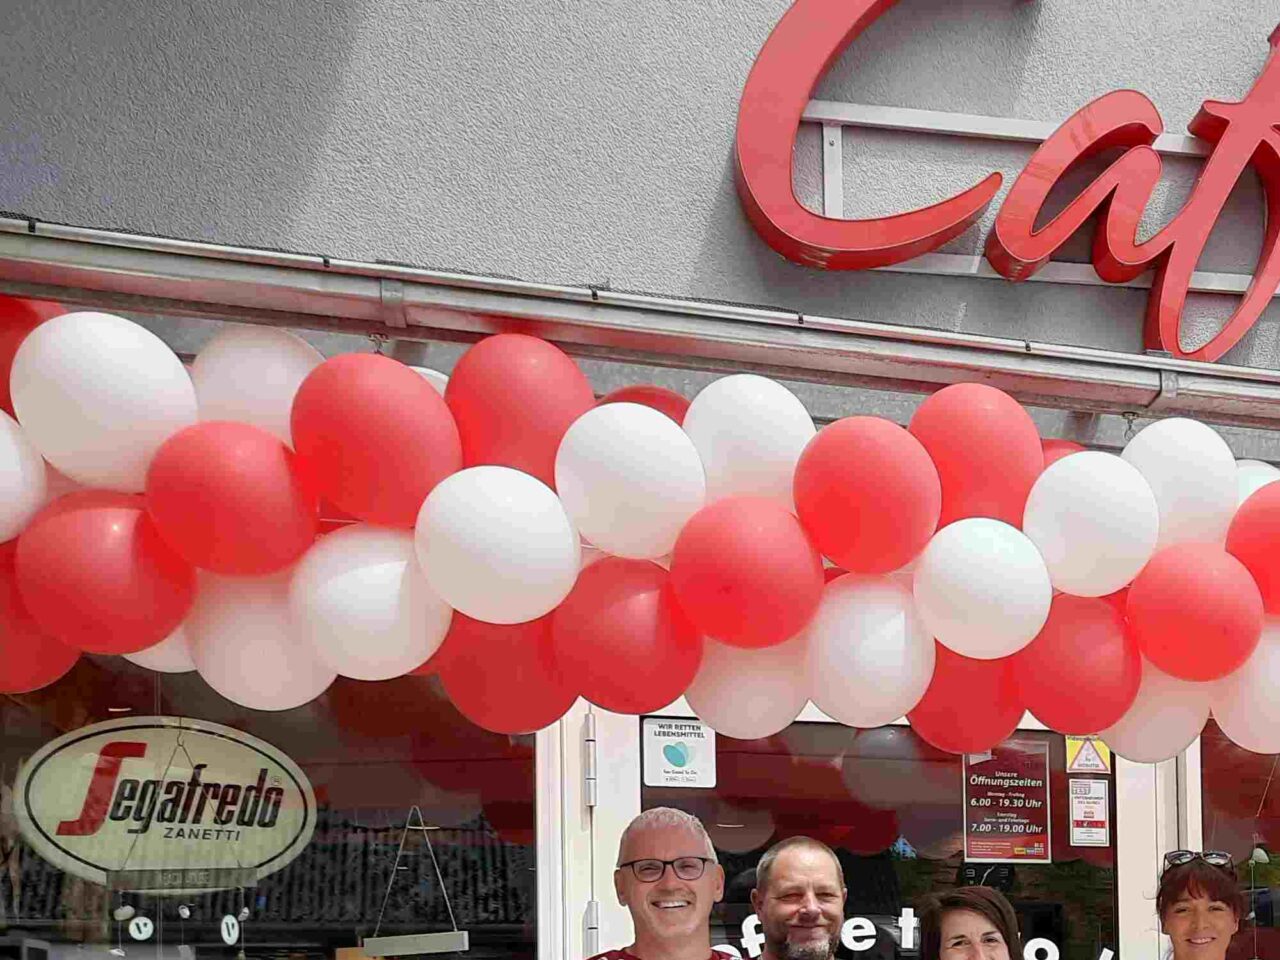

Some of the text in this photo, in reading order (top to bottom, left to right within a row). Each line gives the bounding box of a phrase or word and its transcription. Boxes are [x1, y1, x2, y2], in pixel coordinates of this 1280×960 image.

[674, 723, 702, 731] RETTEN
[653, 730, 706, 739] LEBENSMITTEL
[995, 770, 1018, 778] Unsere
[970, 774, 1043, 788] Öffnungszeiten
[56, 741, 285, 838] Segafredo
[970, 797, 992, 807] 6.00
[999, 798, 1024, 808] 19.30
[1025, 799, 1043, 808] Uhr
[163, 826, 241, 842] ZANETTI
[971, 823, 992, 832] 7.00
[999, 824, 1024, 833] 19.00
[1025, 824, 1043, 834] Uhr
